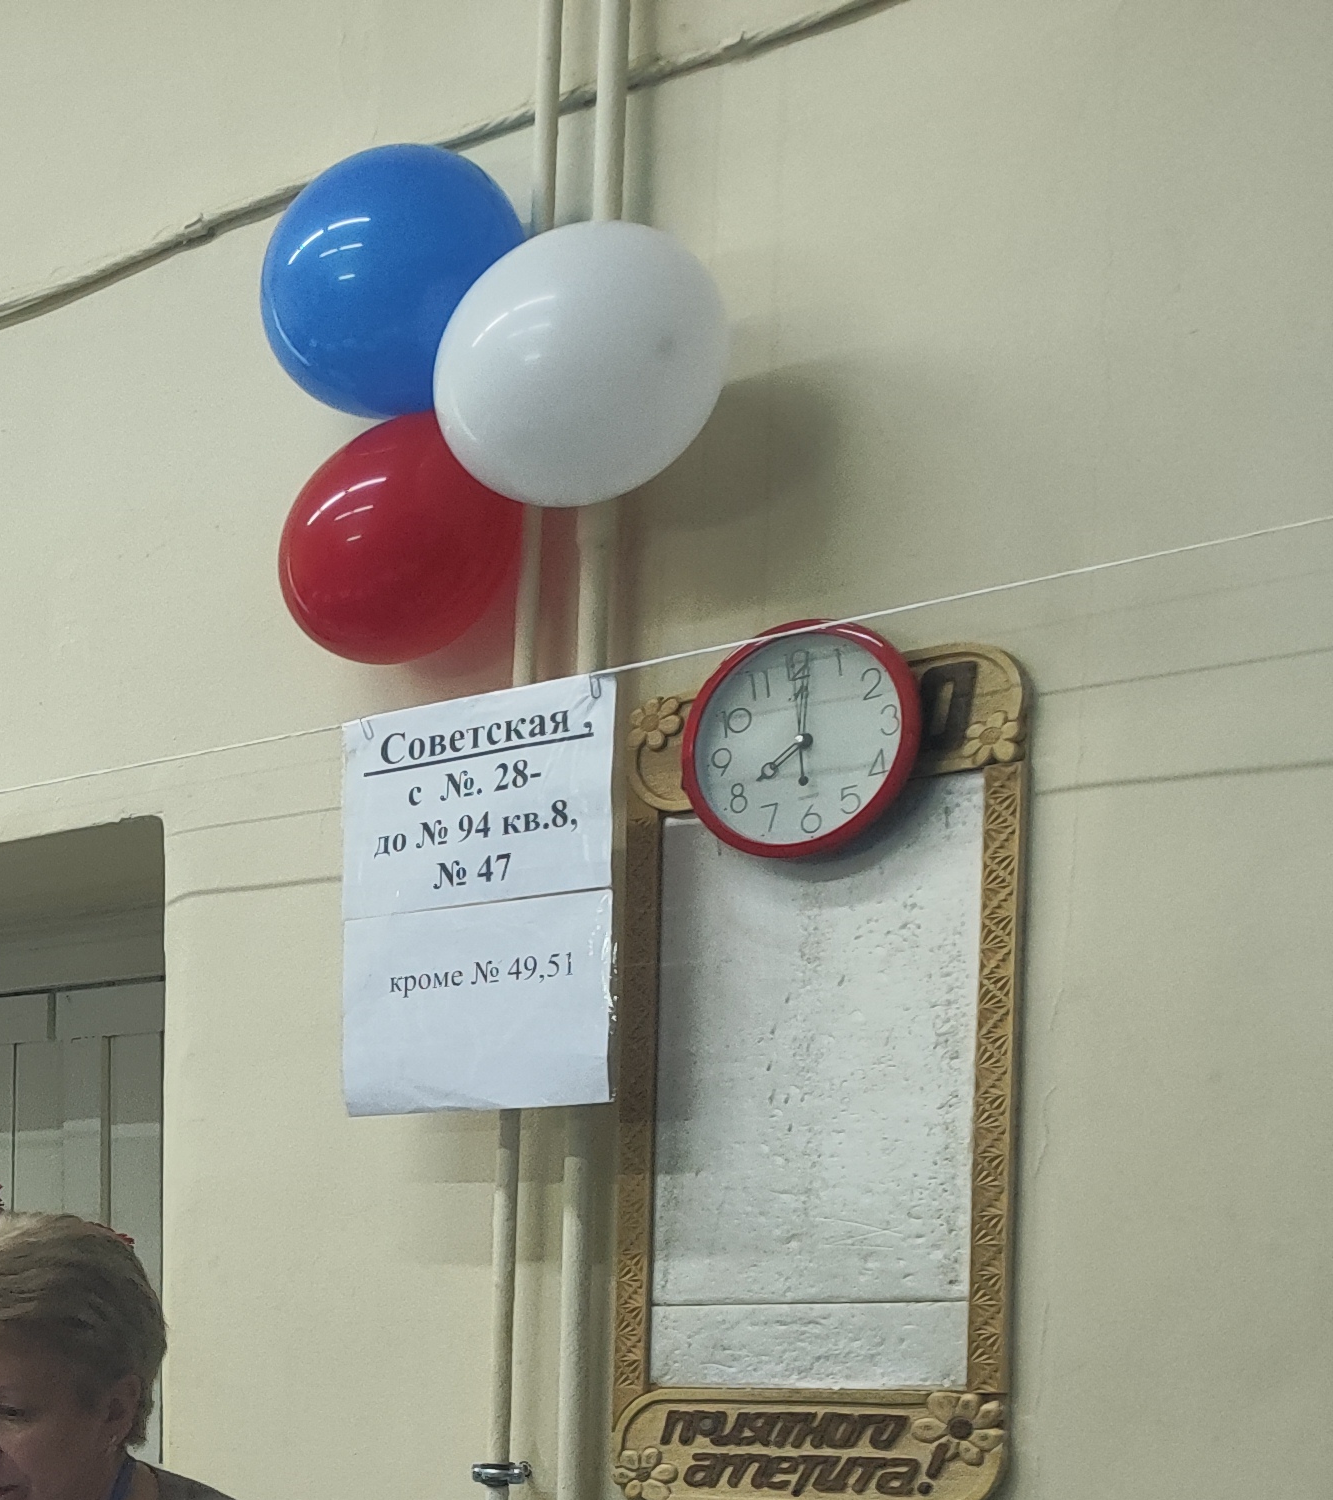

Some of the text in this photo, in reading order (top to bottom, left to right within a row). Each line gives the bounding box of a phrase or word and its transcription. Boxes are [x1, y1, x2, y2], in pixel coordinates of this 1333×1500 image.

[833, 648, 844, 676] 1
[748, 669, 771, 701] 11
[860, 667, 883, 700] 2
[719, 707, 753, 738] 10
[880, 703, 901, 736] 3
[380, 709, 571, 764] Советская
[711, 747, 733, 776] 9
[867, 748, 889, 777] 4
[408, 785, 423, 806] с
[494, 759, 542, 792] 28-
[729, 783, 749, 814] 8
[840, 784, 862, 814] 5
[373, 799, 578, 859] до № 94 кв.8,
[759, 803, 780, 832] 7
[800, 803, 823, 834] 6
[433, 852, 512, 890] № 47
[389, 951, 574, 998] кроме № 49,51
